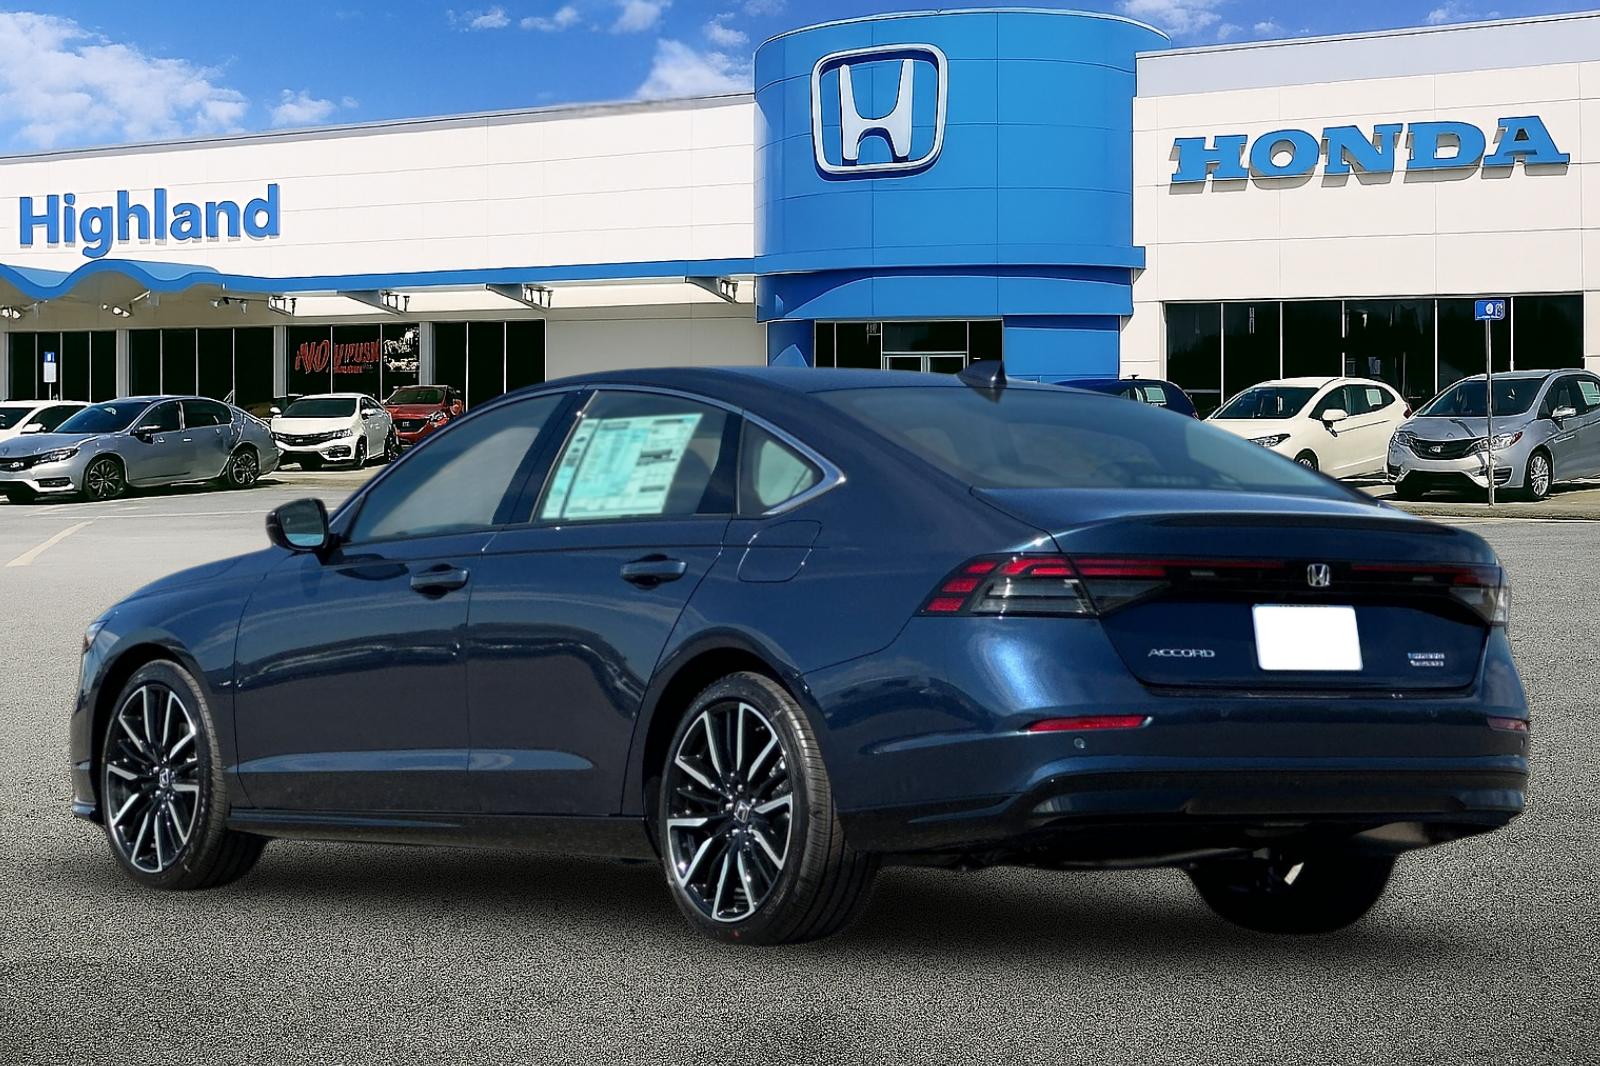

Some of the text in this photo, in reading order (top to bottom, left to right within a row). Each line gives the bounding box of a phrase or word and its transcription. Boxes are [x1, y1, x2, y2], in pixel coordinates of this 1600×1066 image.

[1170, 115, 1570, 184] HONDA
[19, 183, 281, 259] Highland
[1147, 648, 1216, 658] ACCORD
